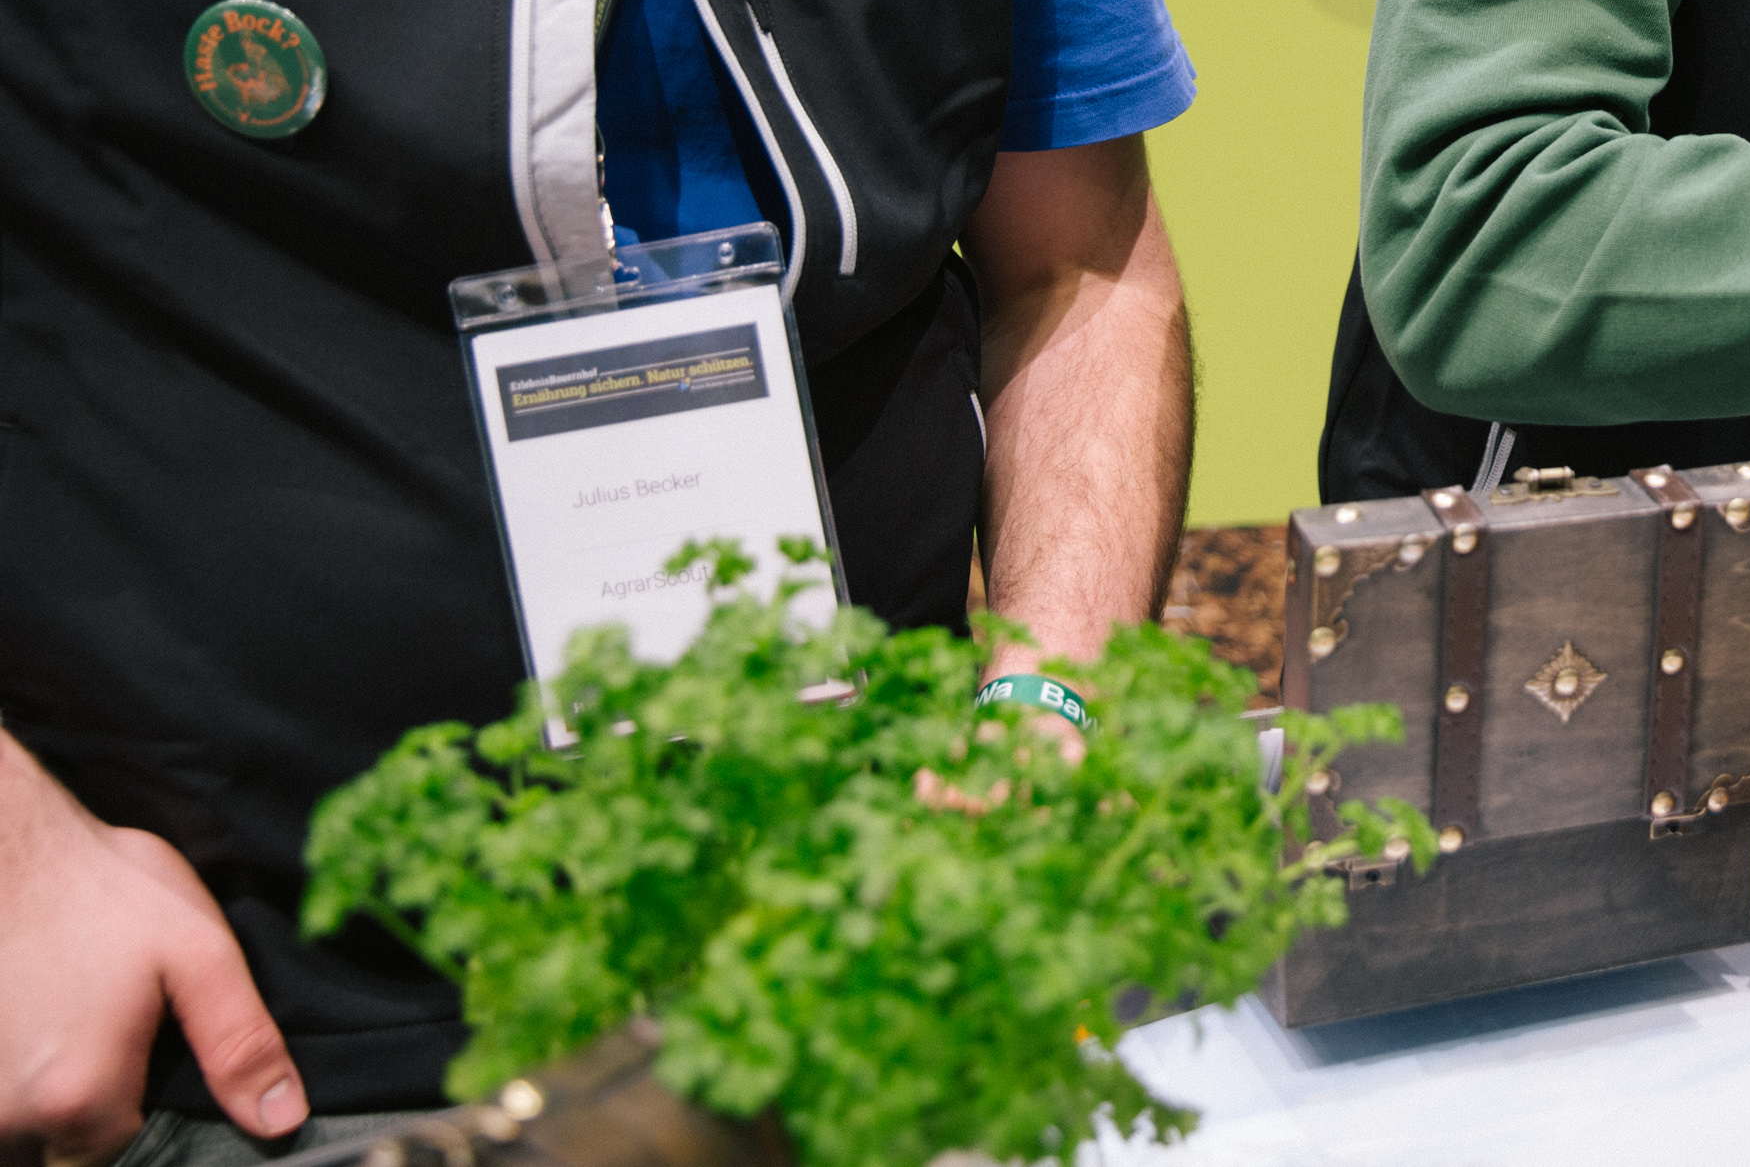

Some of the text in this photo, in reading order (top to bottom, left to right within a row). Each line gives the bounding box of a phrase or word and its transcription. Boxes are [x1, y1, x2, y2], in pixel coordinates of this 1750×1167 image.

[222, 9, 301, 51] Bock?
[512, 383, 588, 409] Ernährung
[589, 373, 646, 396] sichern.
[645, 367, 687, 386] Natur
[688, 355, 755, 378] schützen.
[572, 472, 702, 510] Julius Becker
